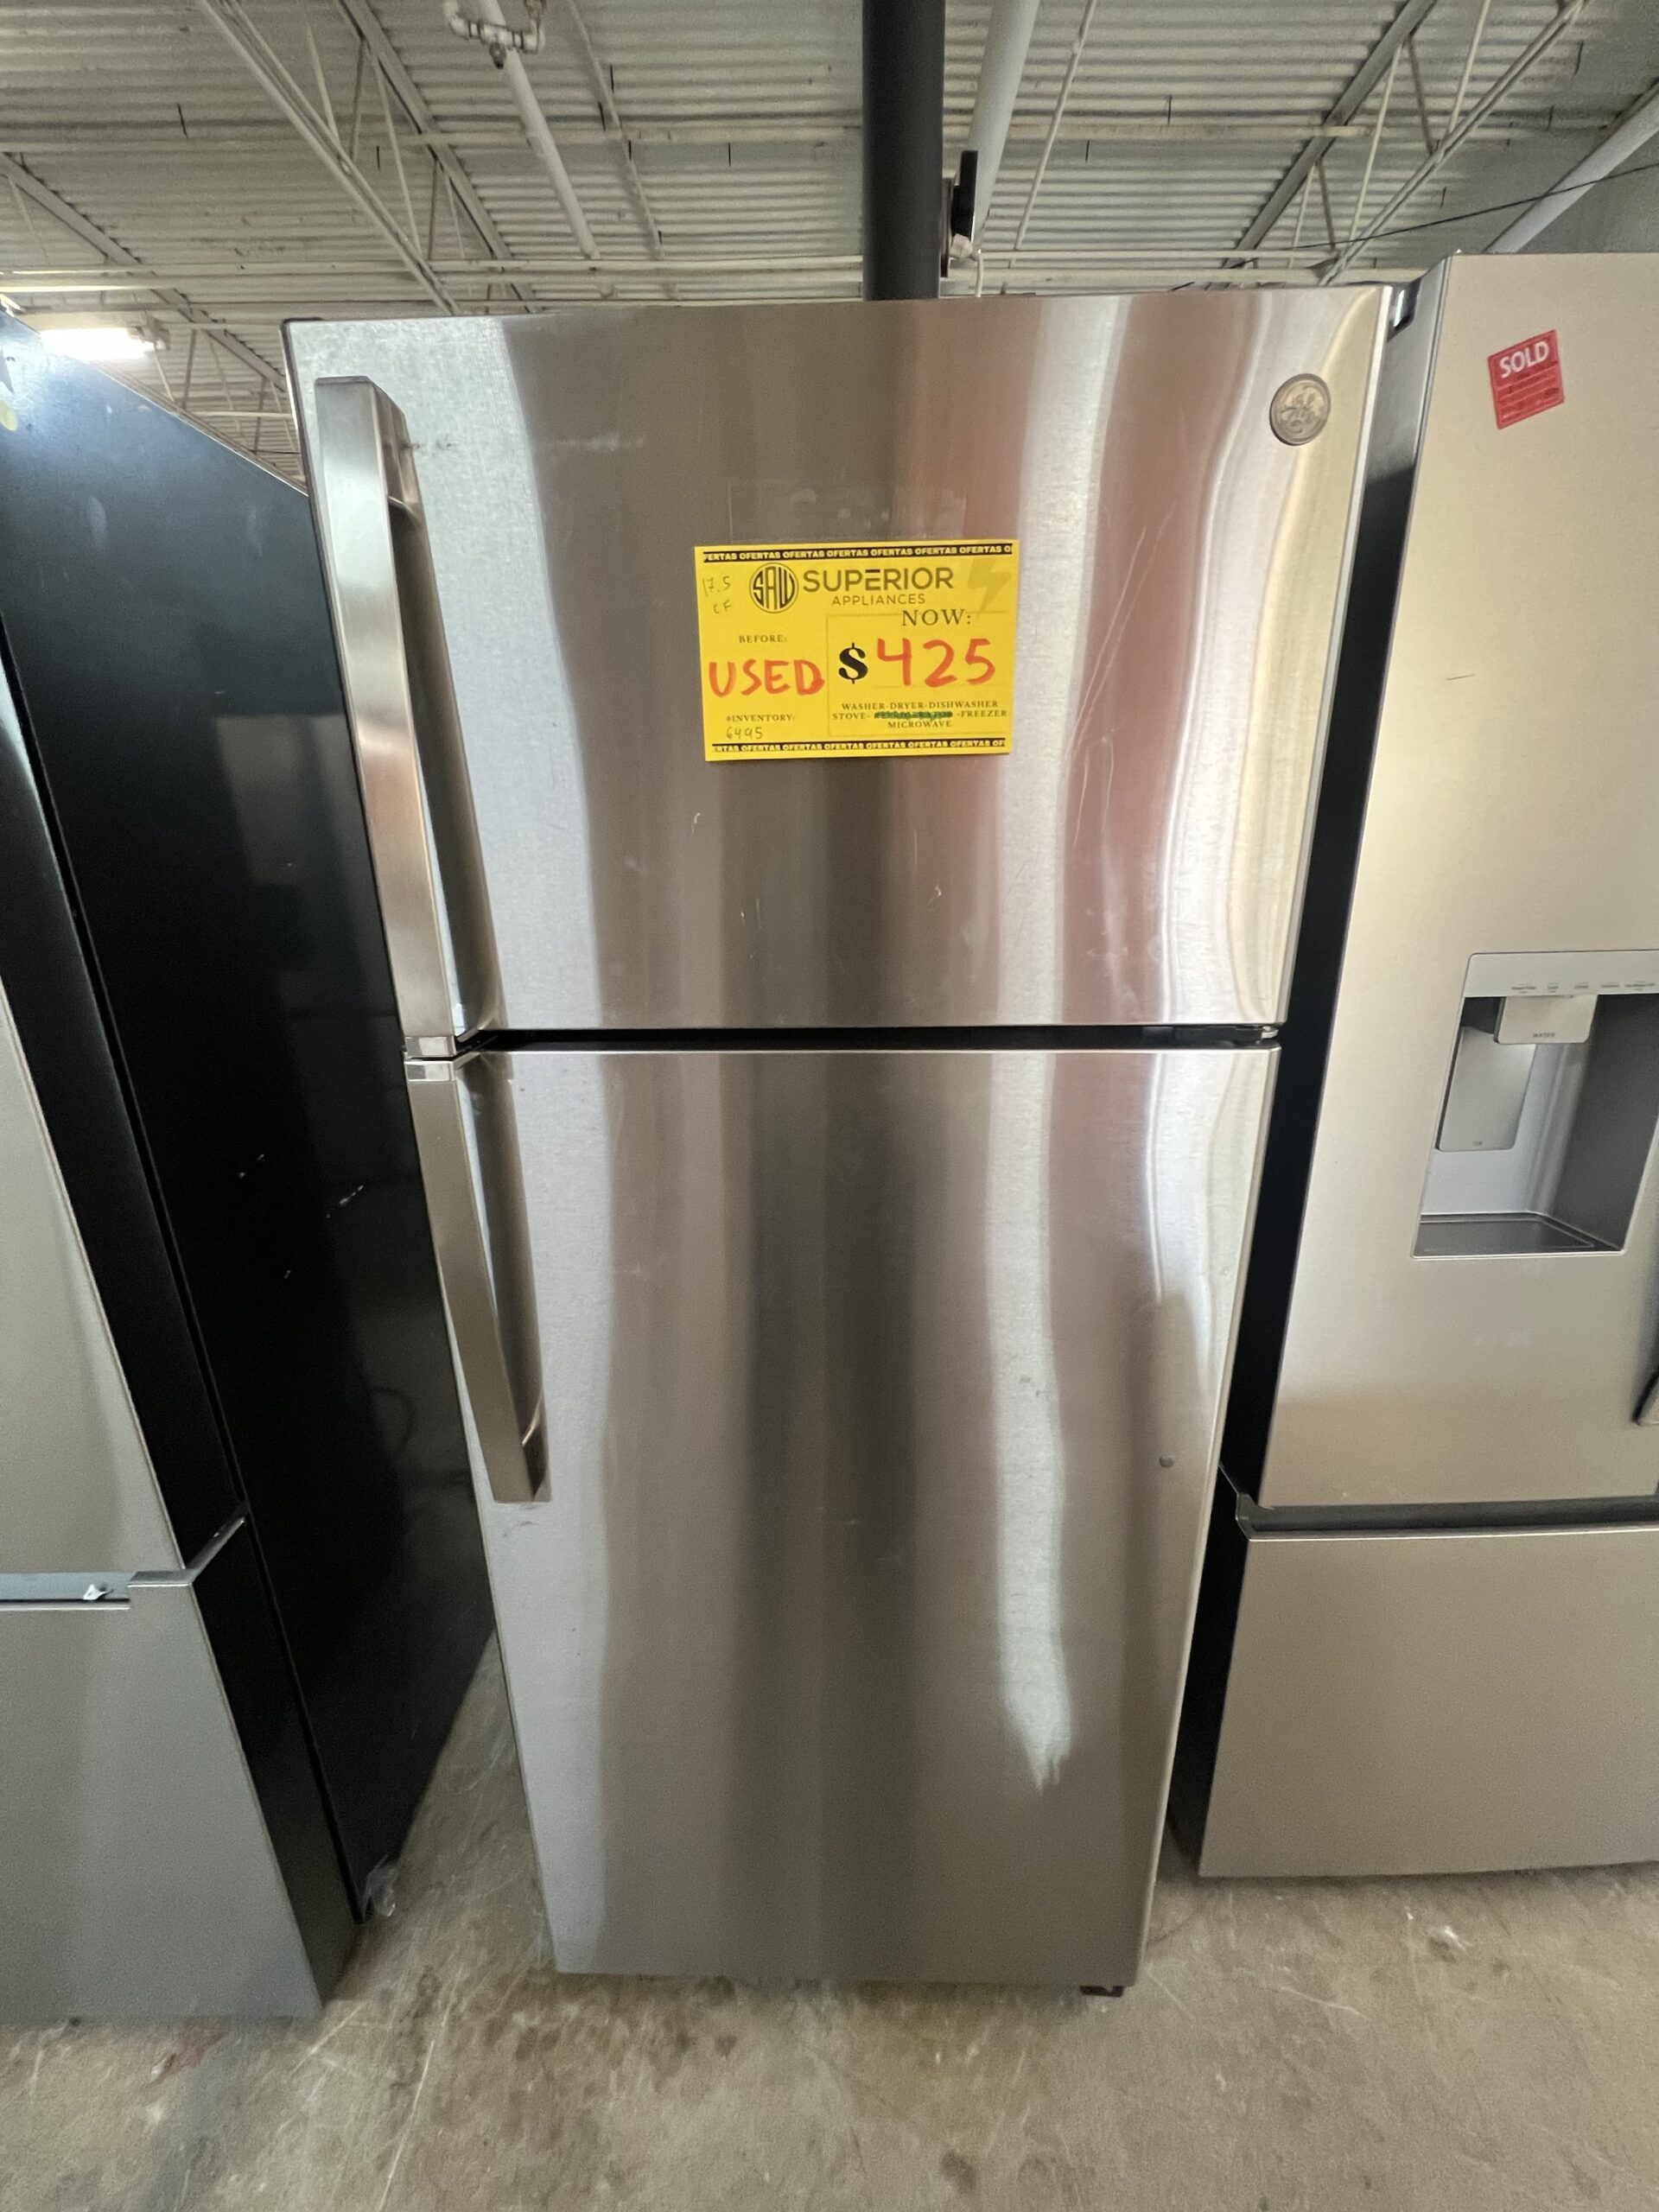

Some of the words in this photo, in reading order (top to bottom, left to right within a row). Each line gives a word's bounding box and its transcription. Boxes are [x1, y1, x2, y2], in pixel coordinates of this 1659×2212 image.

[1499, 340, 1549, 378] SOLD
[739, 551, 781, 560] OFERTAS
[826, 549, 868, 557] OFERTAS
[870, 548, 913, 556] OFERTAS
[914, 546, 957, 555] OFERTAS
[959, 545, 1002, 554] OFERTAS
[803, 567, 954, 593] SUPERIOR
[832, 594, 926, 607] APPLIANCES
[901, 608, 971, 626] NOW:
[739, 634, 787, 644] BEFORE:
[709, 658, 825, 697] USED
[887, 721, 952, 729] MICROWAVE
